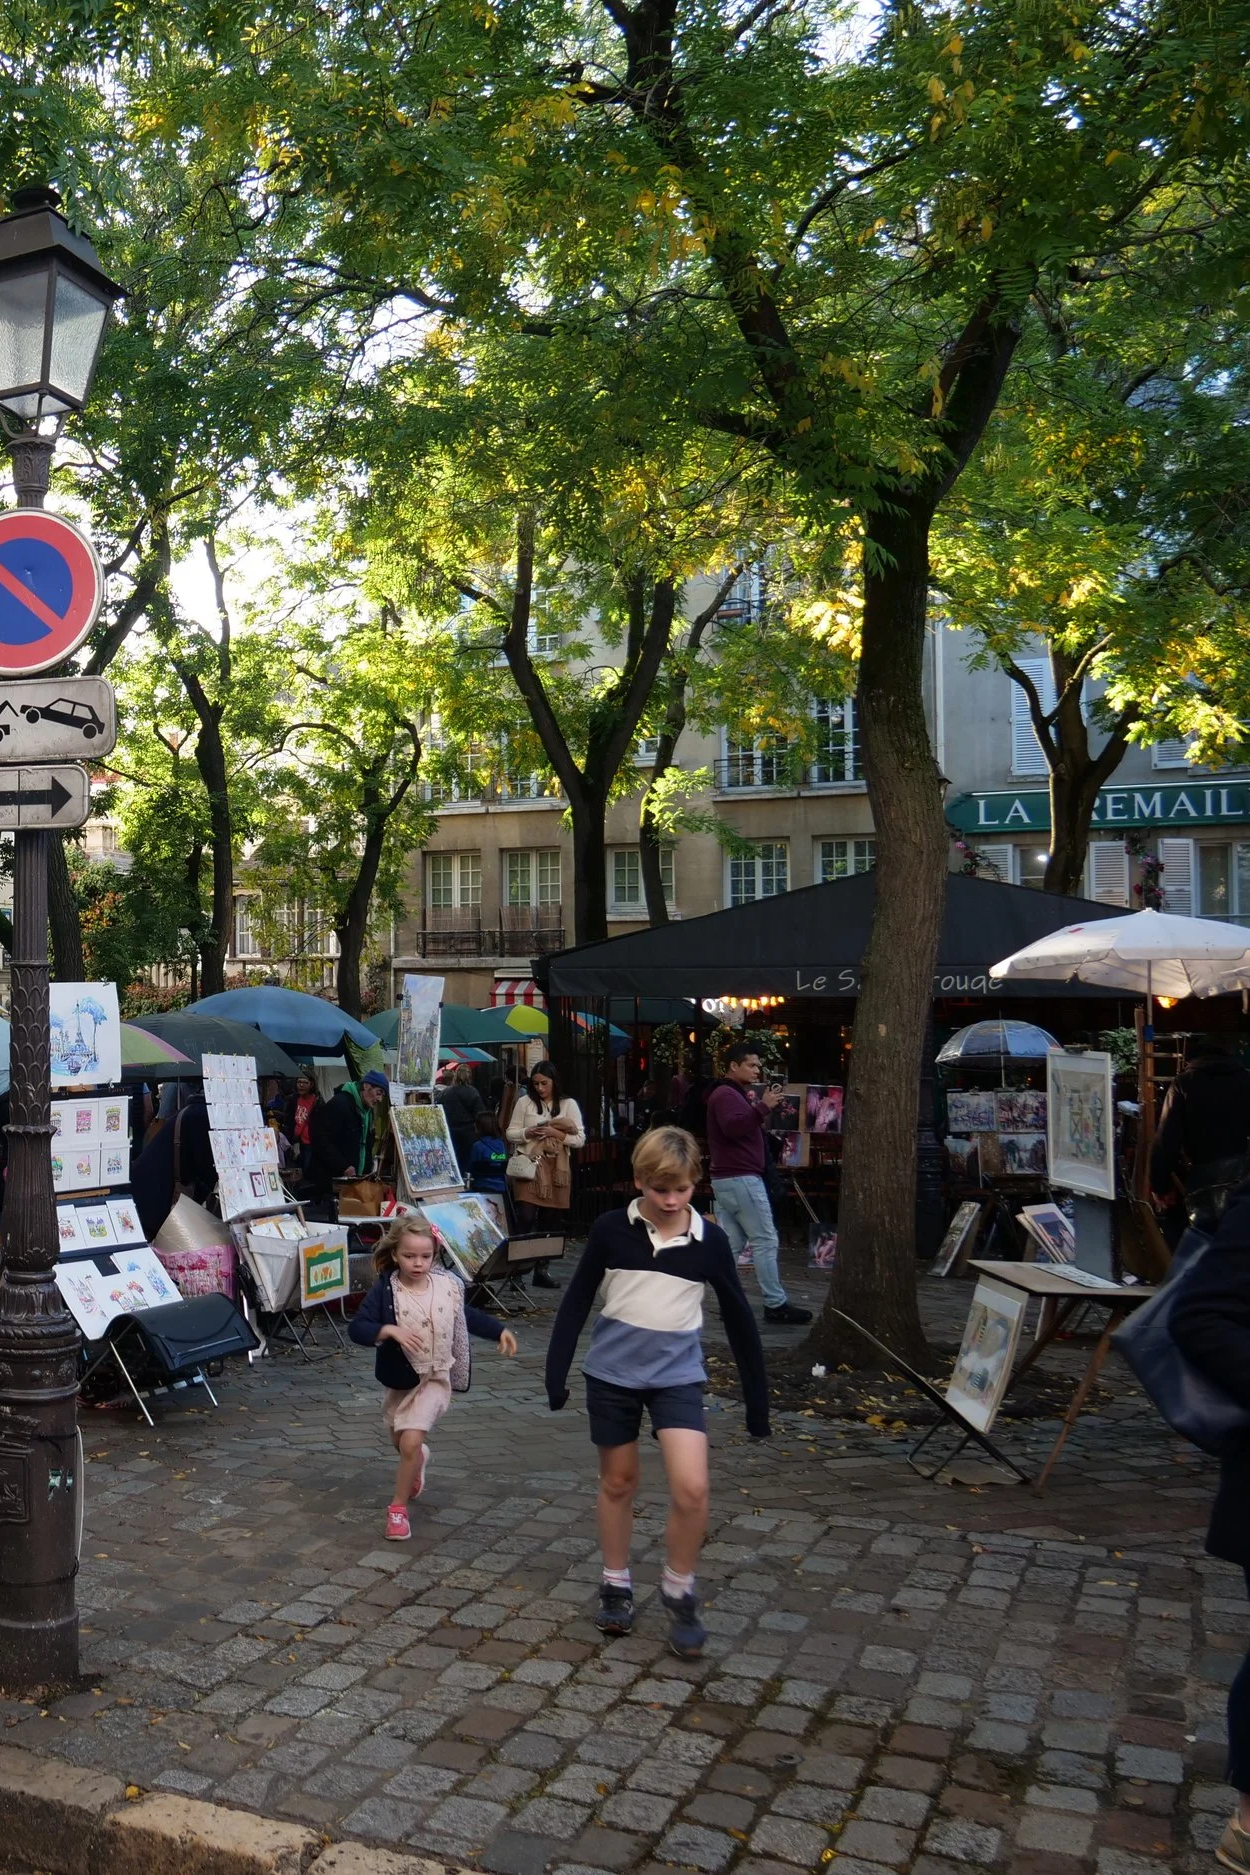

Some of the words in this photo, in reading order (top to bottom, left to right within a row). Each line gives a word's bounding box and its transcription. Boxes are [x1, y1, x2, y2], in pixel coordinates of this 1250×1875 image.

[977, 798, 1031, 825] LA
[796, 970, 827, 991] Le
[934, 975, 1004, 994] ouge
